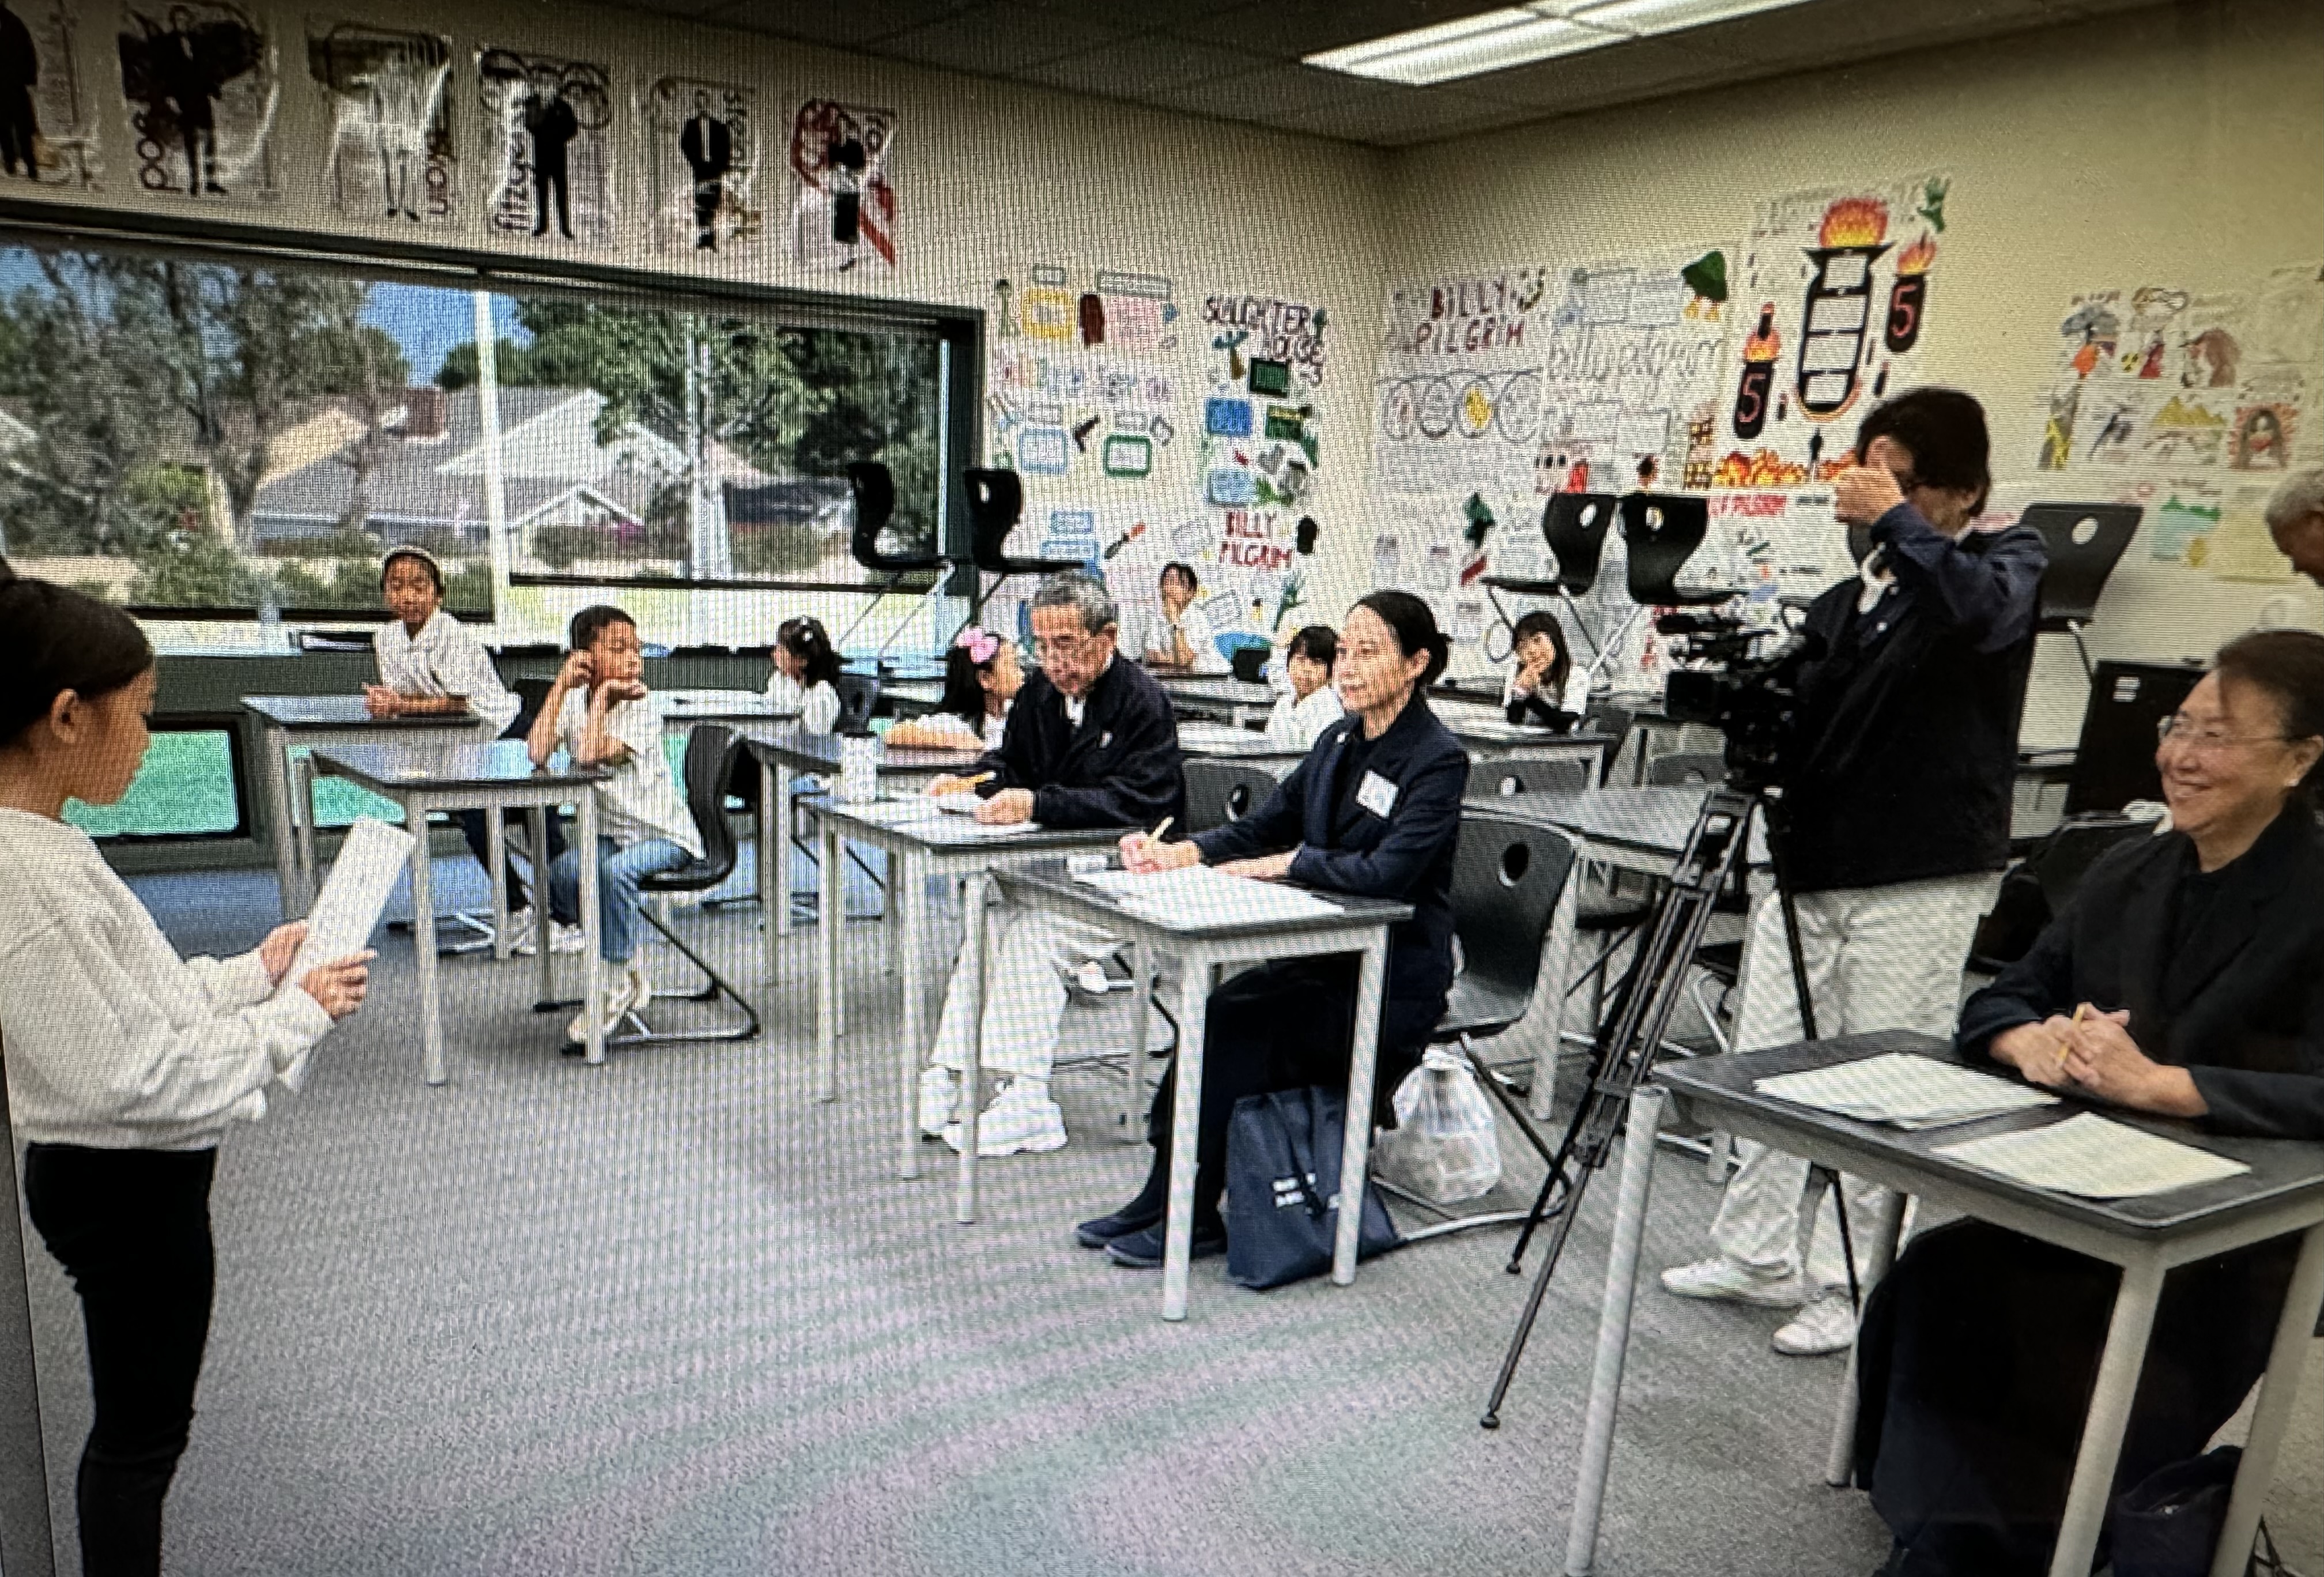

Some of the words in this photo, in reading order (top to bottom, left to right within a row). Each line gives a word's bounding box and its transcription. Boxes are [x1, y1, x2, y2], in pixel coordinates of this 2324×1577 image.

[1431, 276, 1506, 319] BILLY
[1892, 284, 1918, 338] 5
[1737, 373, 1767, 422] 5
[1226, 511, 1277, 538] BILLY
